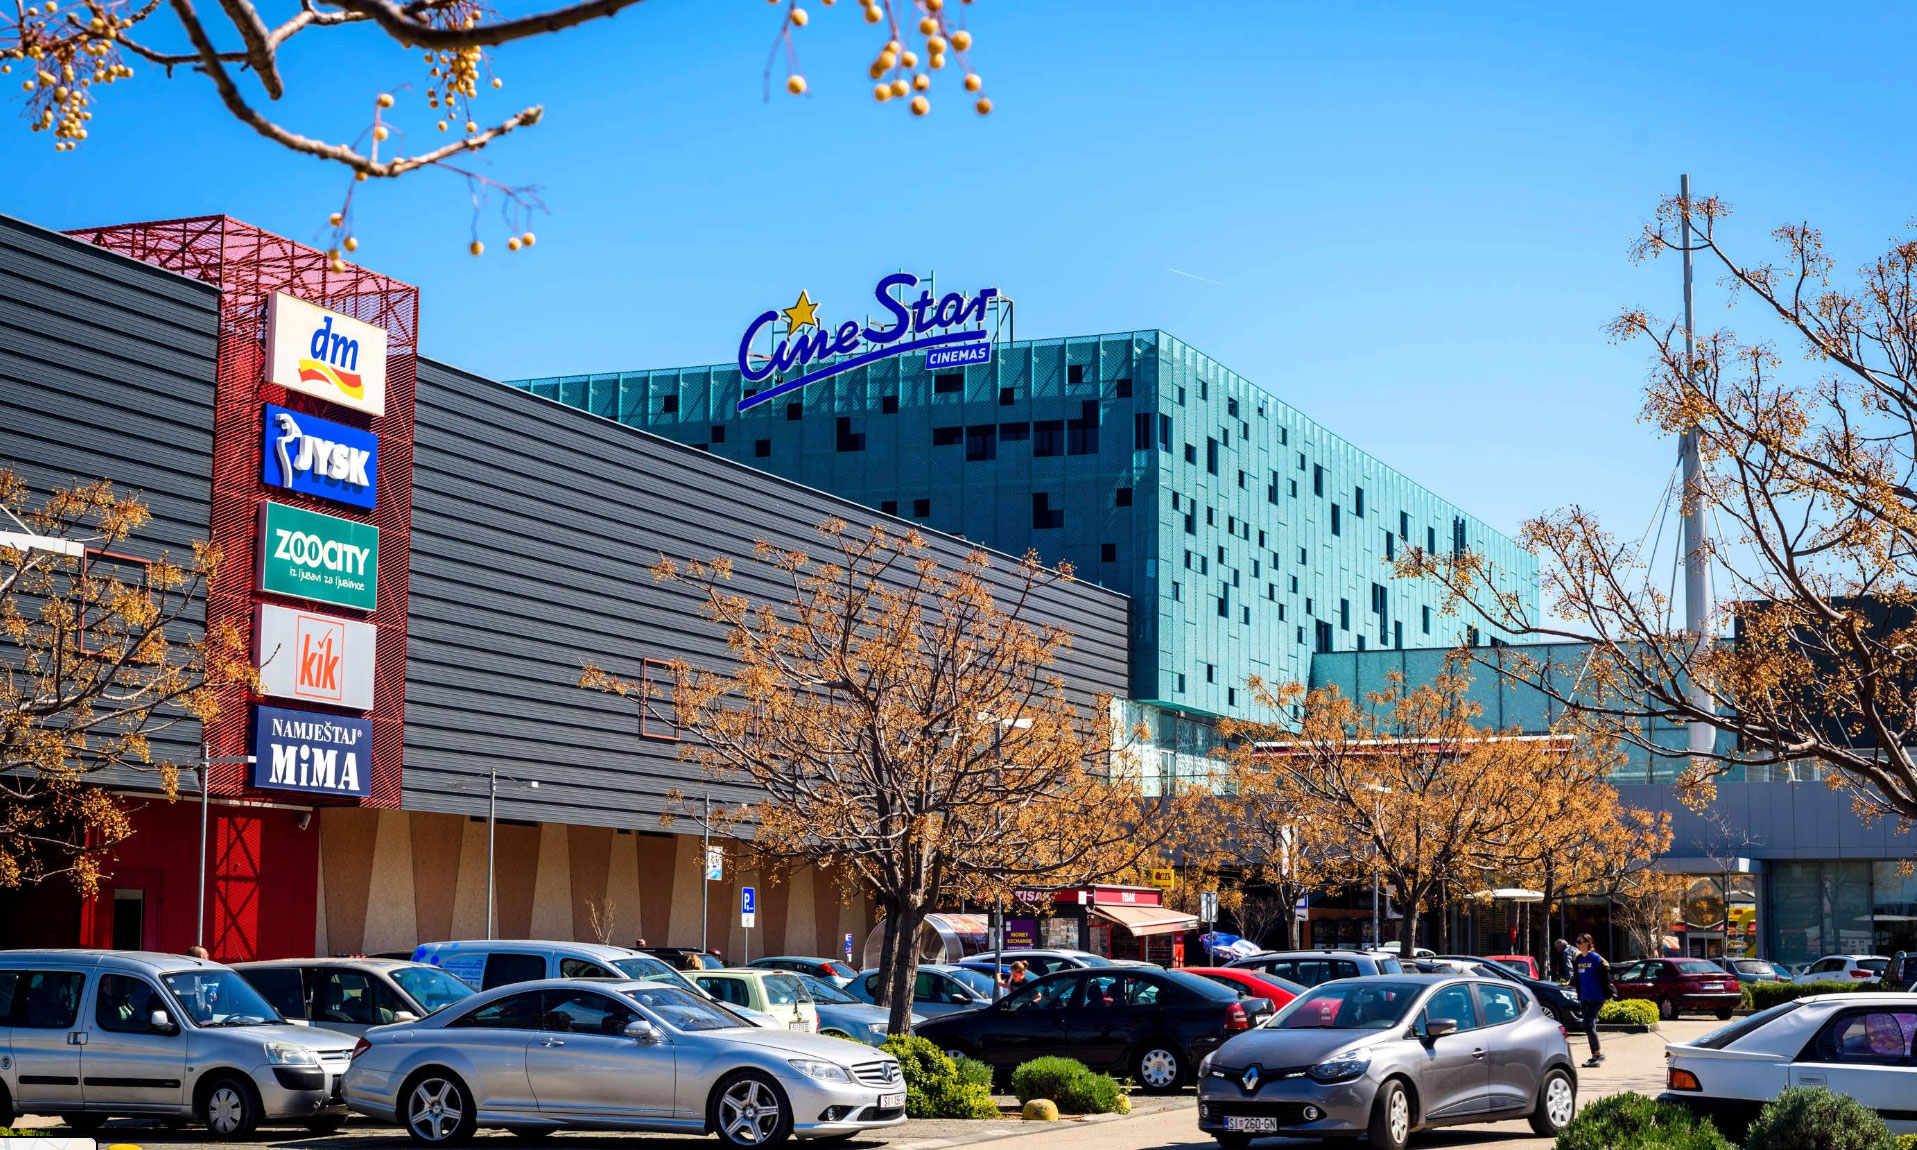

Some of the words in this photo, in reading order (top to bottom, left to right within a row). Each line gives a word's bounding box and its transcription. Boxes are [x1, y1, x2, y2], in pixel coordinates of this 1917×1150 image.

[311, 316, 359, 371] dm
[929, 347, 987, 366] CINEMAS
[294, 434, 371, 487] JYSK
[289, 566, 297, 577] iz
[324, 575, 333, 585] za
